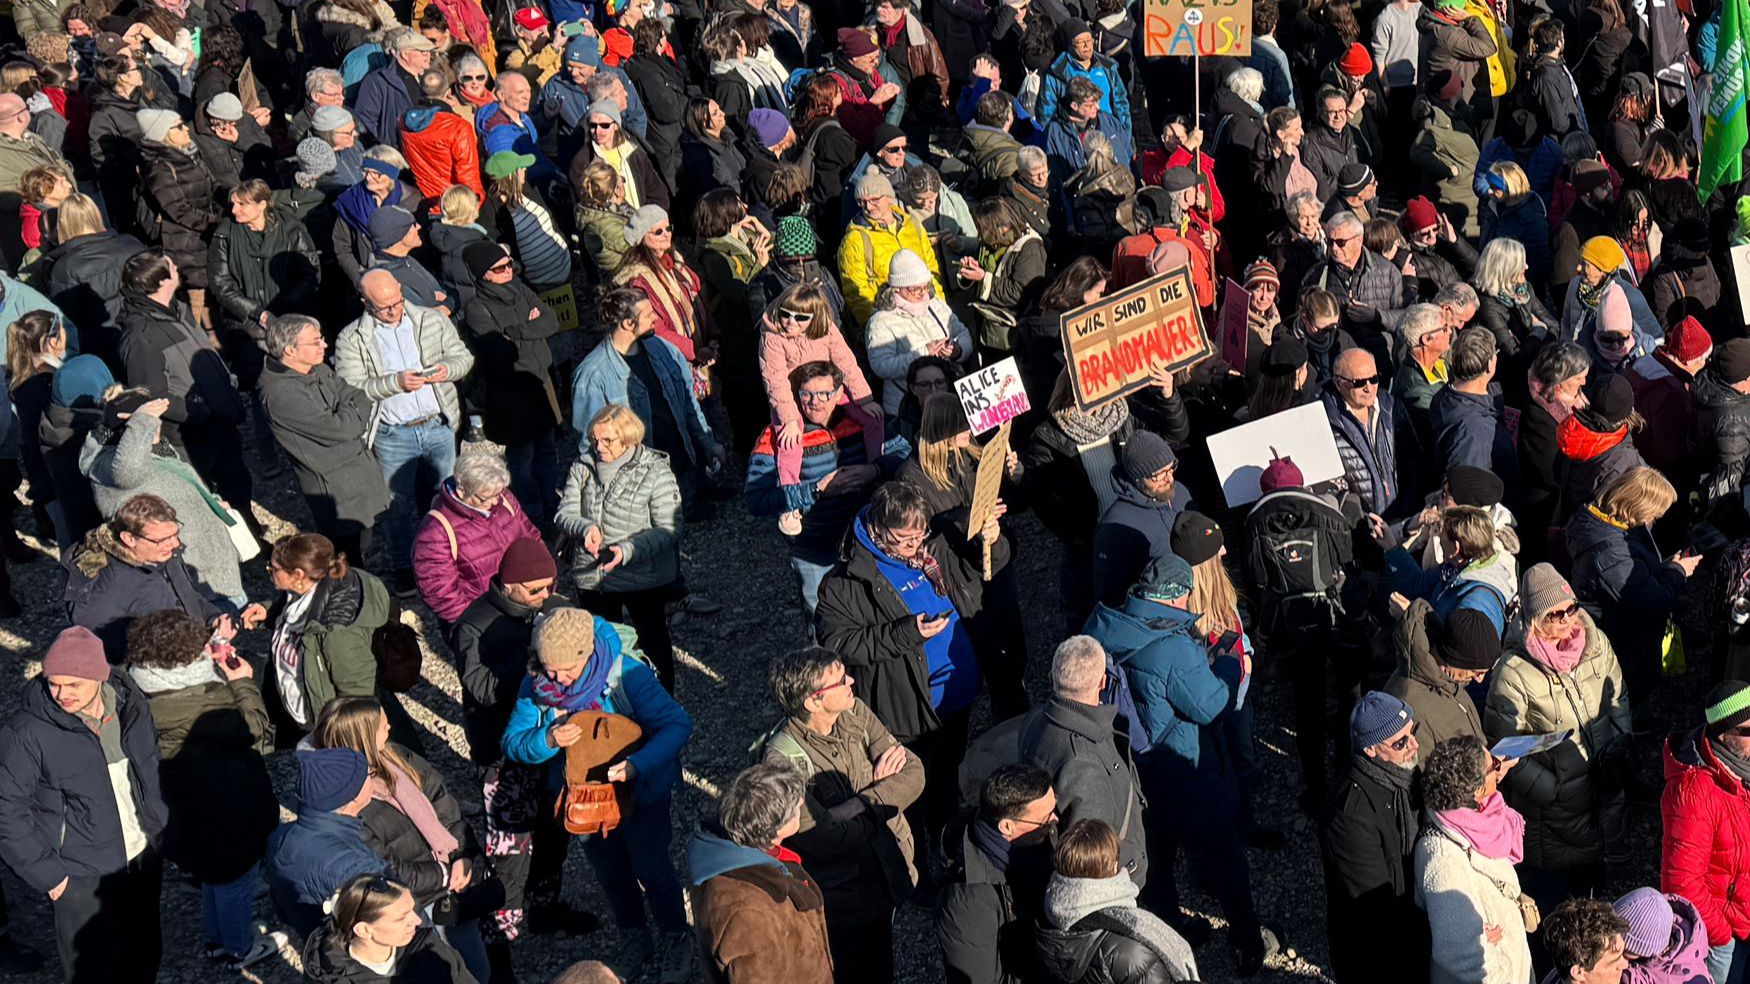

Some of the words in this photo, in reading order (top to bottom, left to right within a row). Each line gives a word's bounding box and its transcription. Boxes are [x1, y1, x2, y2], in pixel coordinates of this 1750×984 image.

[1074, 312, 1106, 339] WIR
[1113, 297, 1147, 325] SIND
[1158, 280, 1183, 304] DIE
[1079, 323, 1196, 396] BRANDMAUER!
[959, 366, 1002, 401] ALICE
[962, 391, 992, 418] INS
